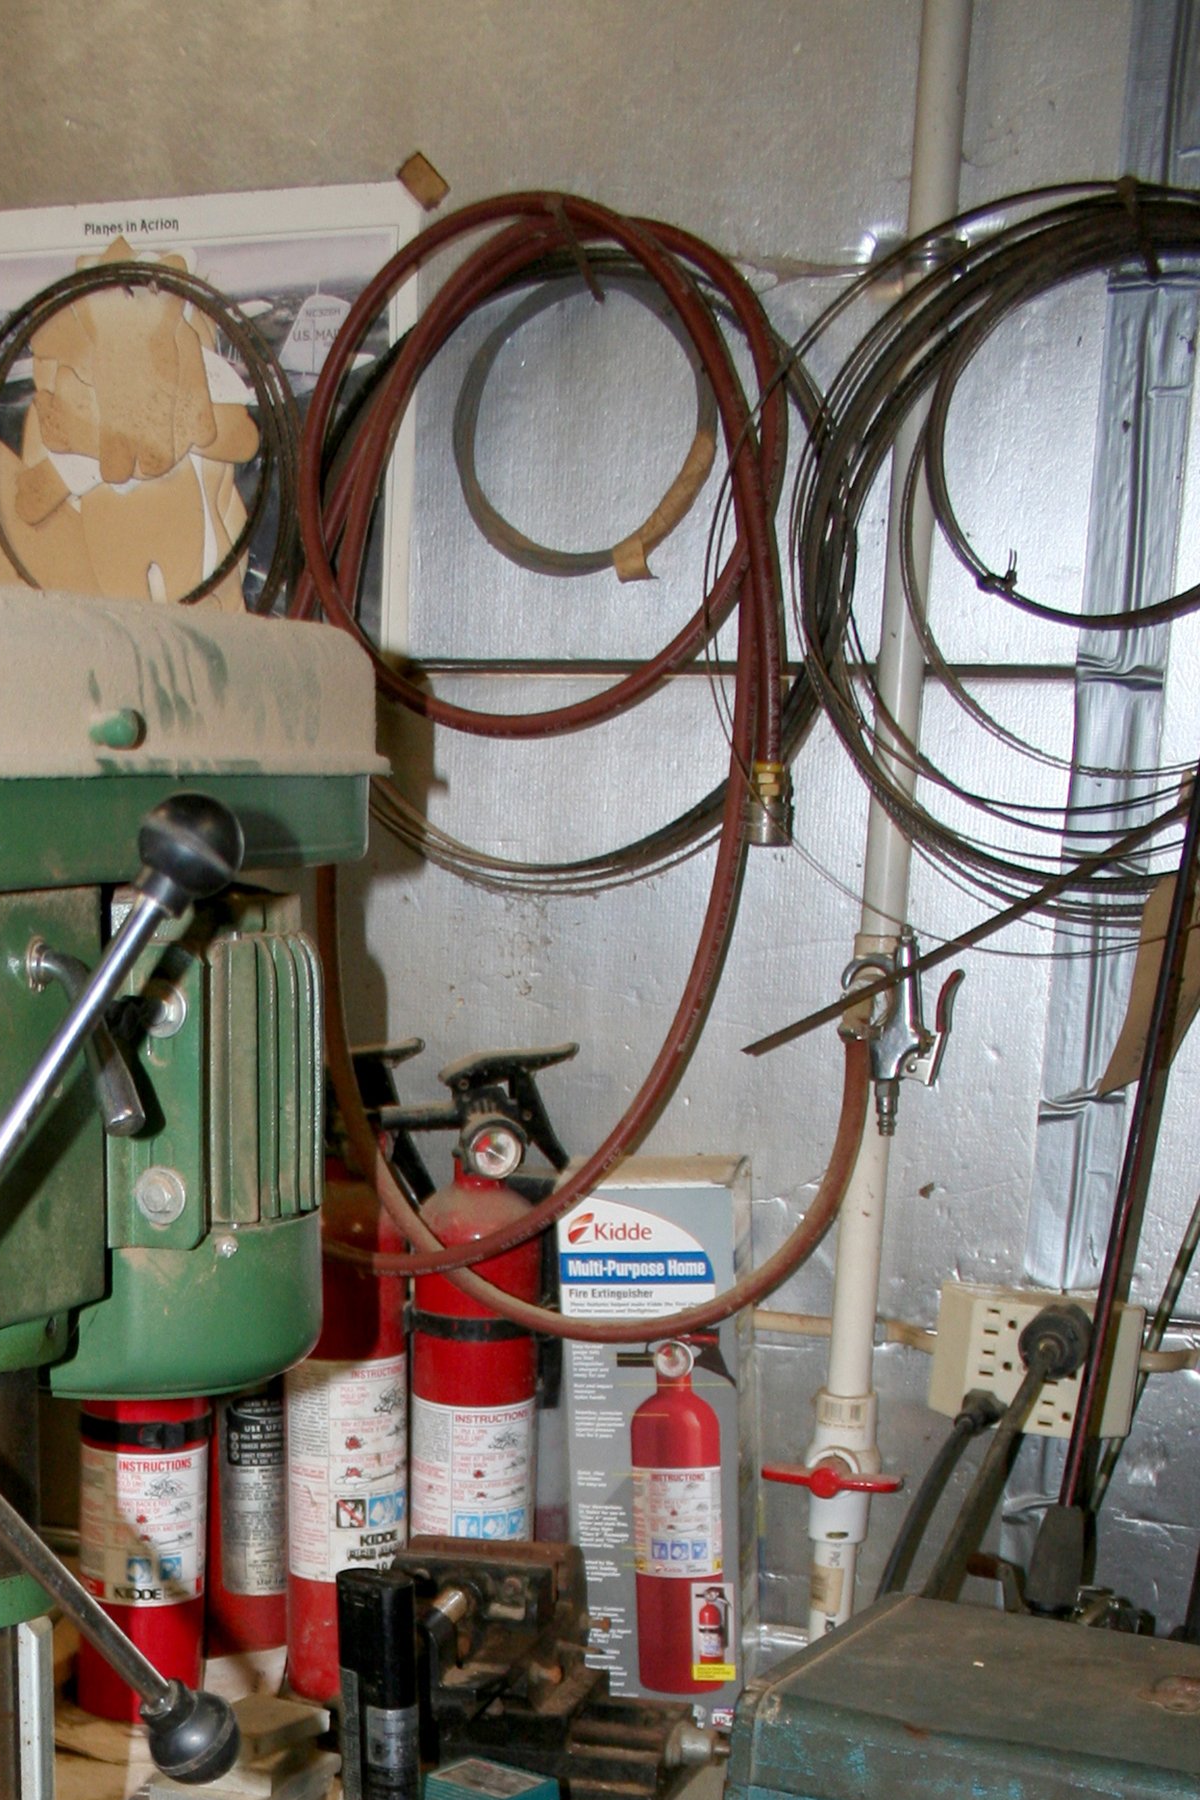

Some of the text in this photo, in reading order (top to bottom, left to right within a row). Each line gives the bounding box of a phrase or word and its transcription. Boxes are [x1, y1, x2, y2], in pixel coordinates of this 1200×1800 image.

[84, 218, 180, 237] Planes in Action
[594, 1222, 653, 1241] Kidde
[568, 1259, 707, 1280] Multi-Purpose Home
[569, 1288, 654, 1300] Fire Extinguisher
[455, 1408, 528, 1424] INSTRUCTIONS
[119, 1457, 192, 1473] INSTRUCTIONS
[360, 1531, 398, 1547] KIDDE
[114, 1588, 162, 1601] KIDDE
